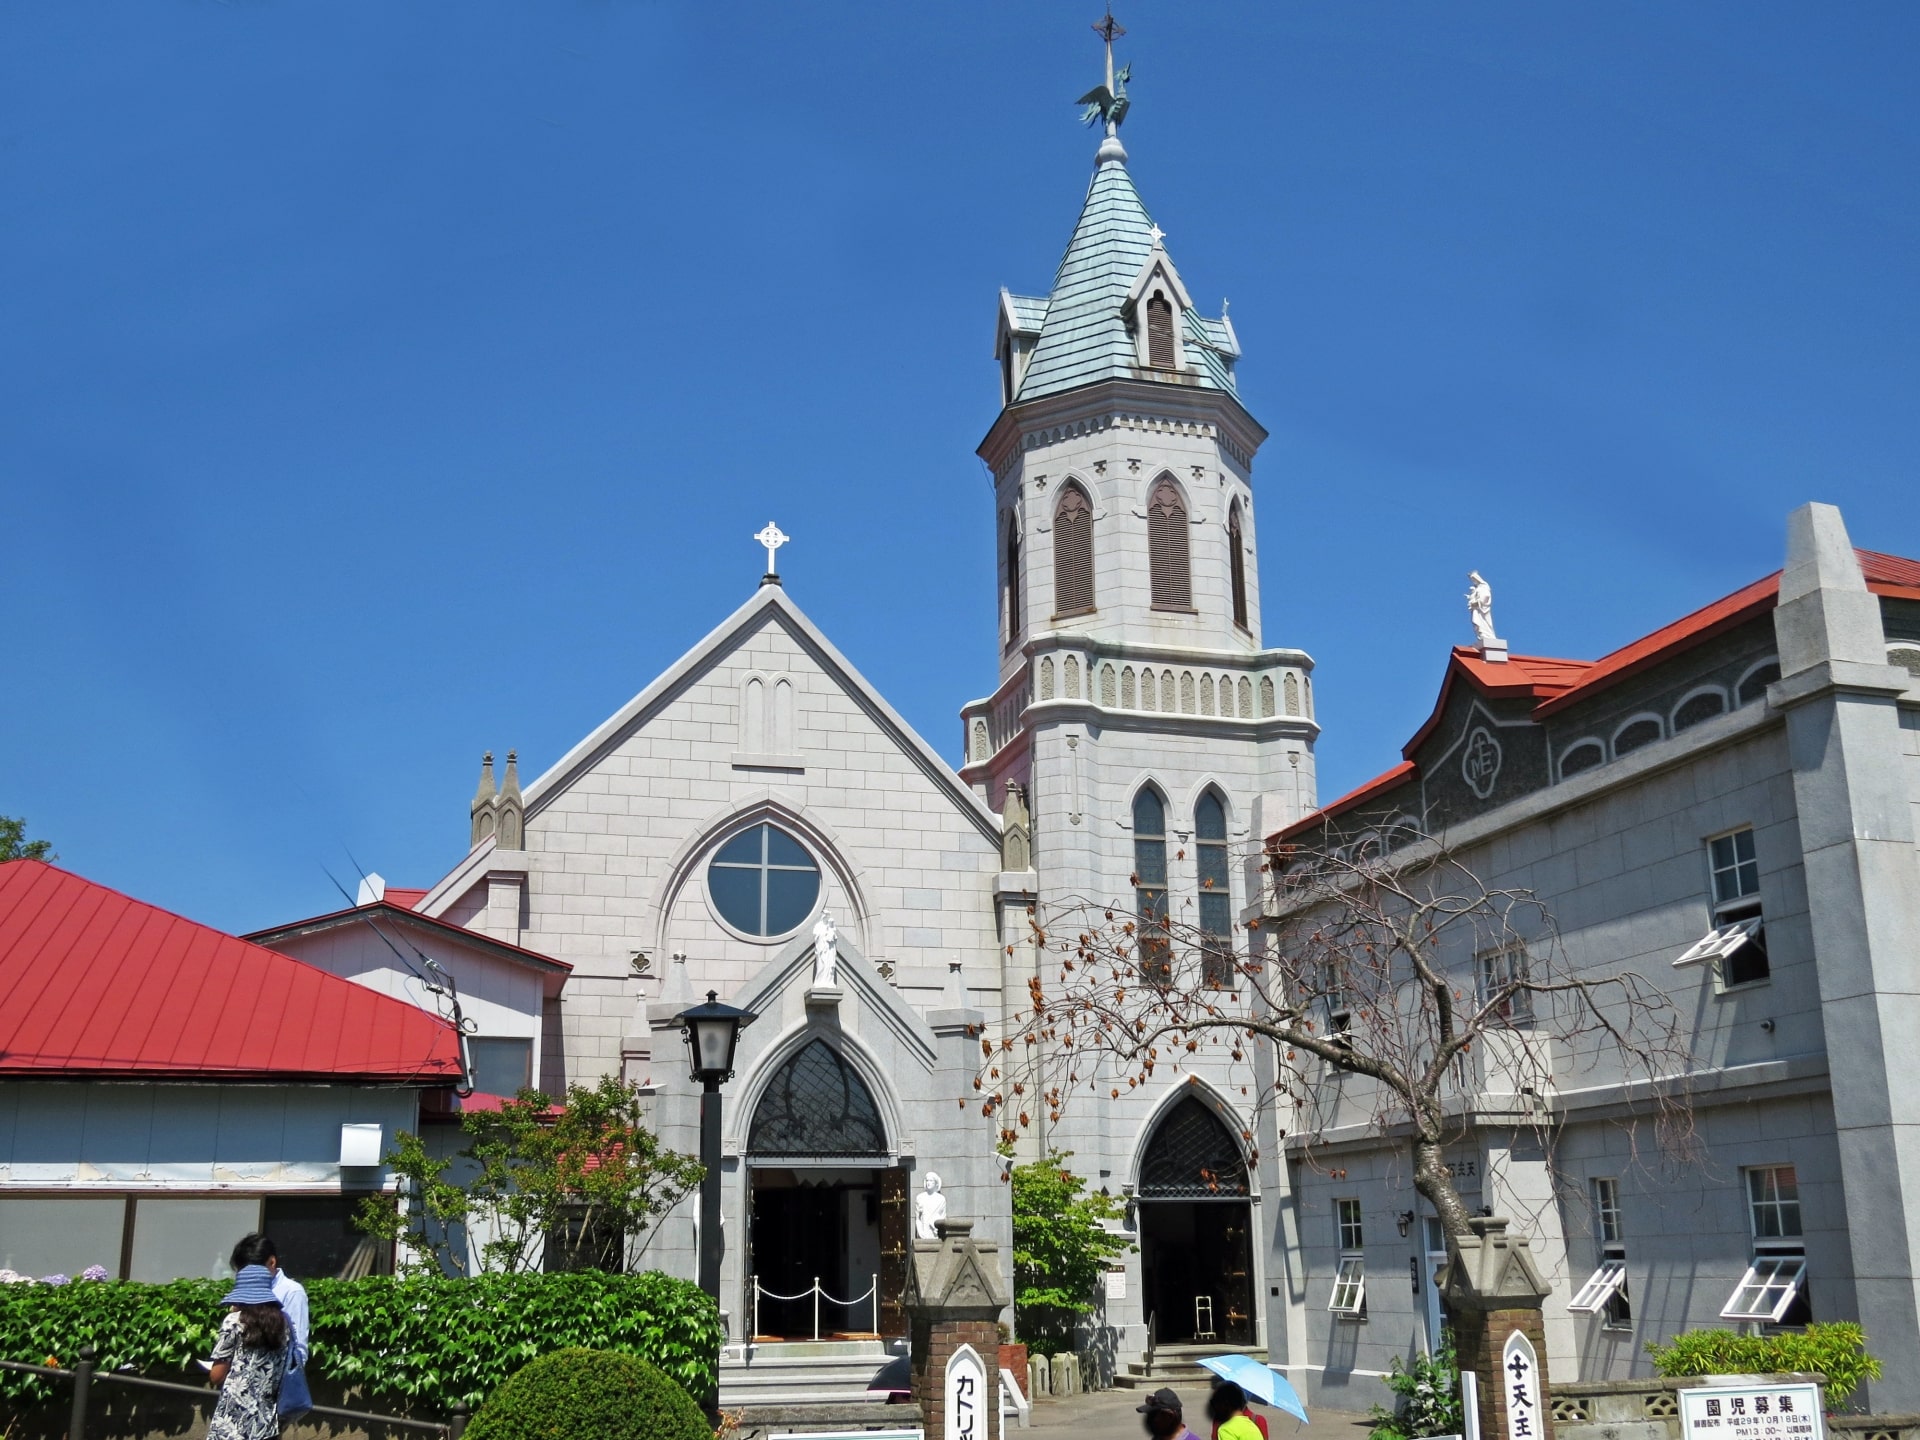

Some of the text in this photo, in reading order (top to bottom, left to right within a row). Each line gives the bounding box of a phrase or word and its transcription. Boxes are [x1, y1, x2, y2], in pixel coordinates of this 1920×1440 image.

[1511, 1384, 1533, 1437] 天主
[1707, 1396, 1793, 1416] 園児募集
